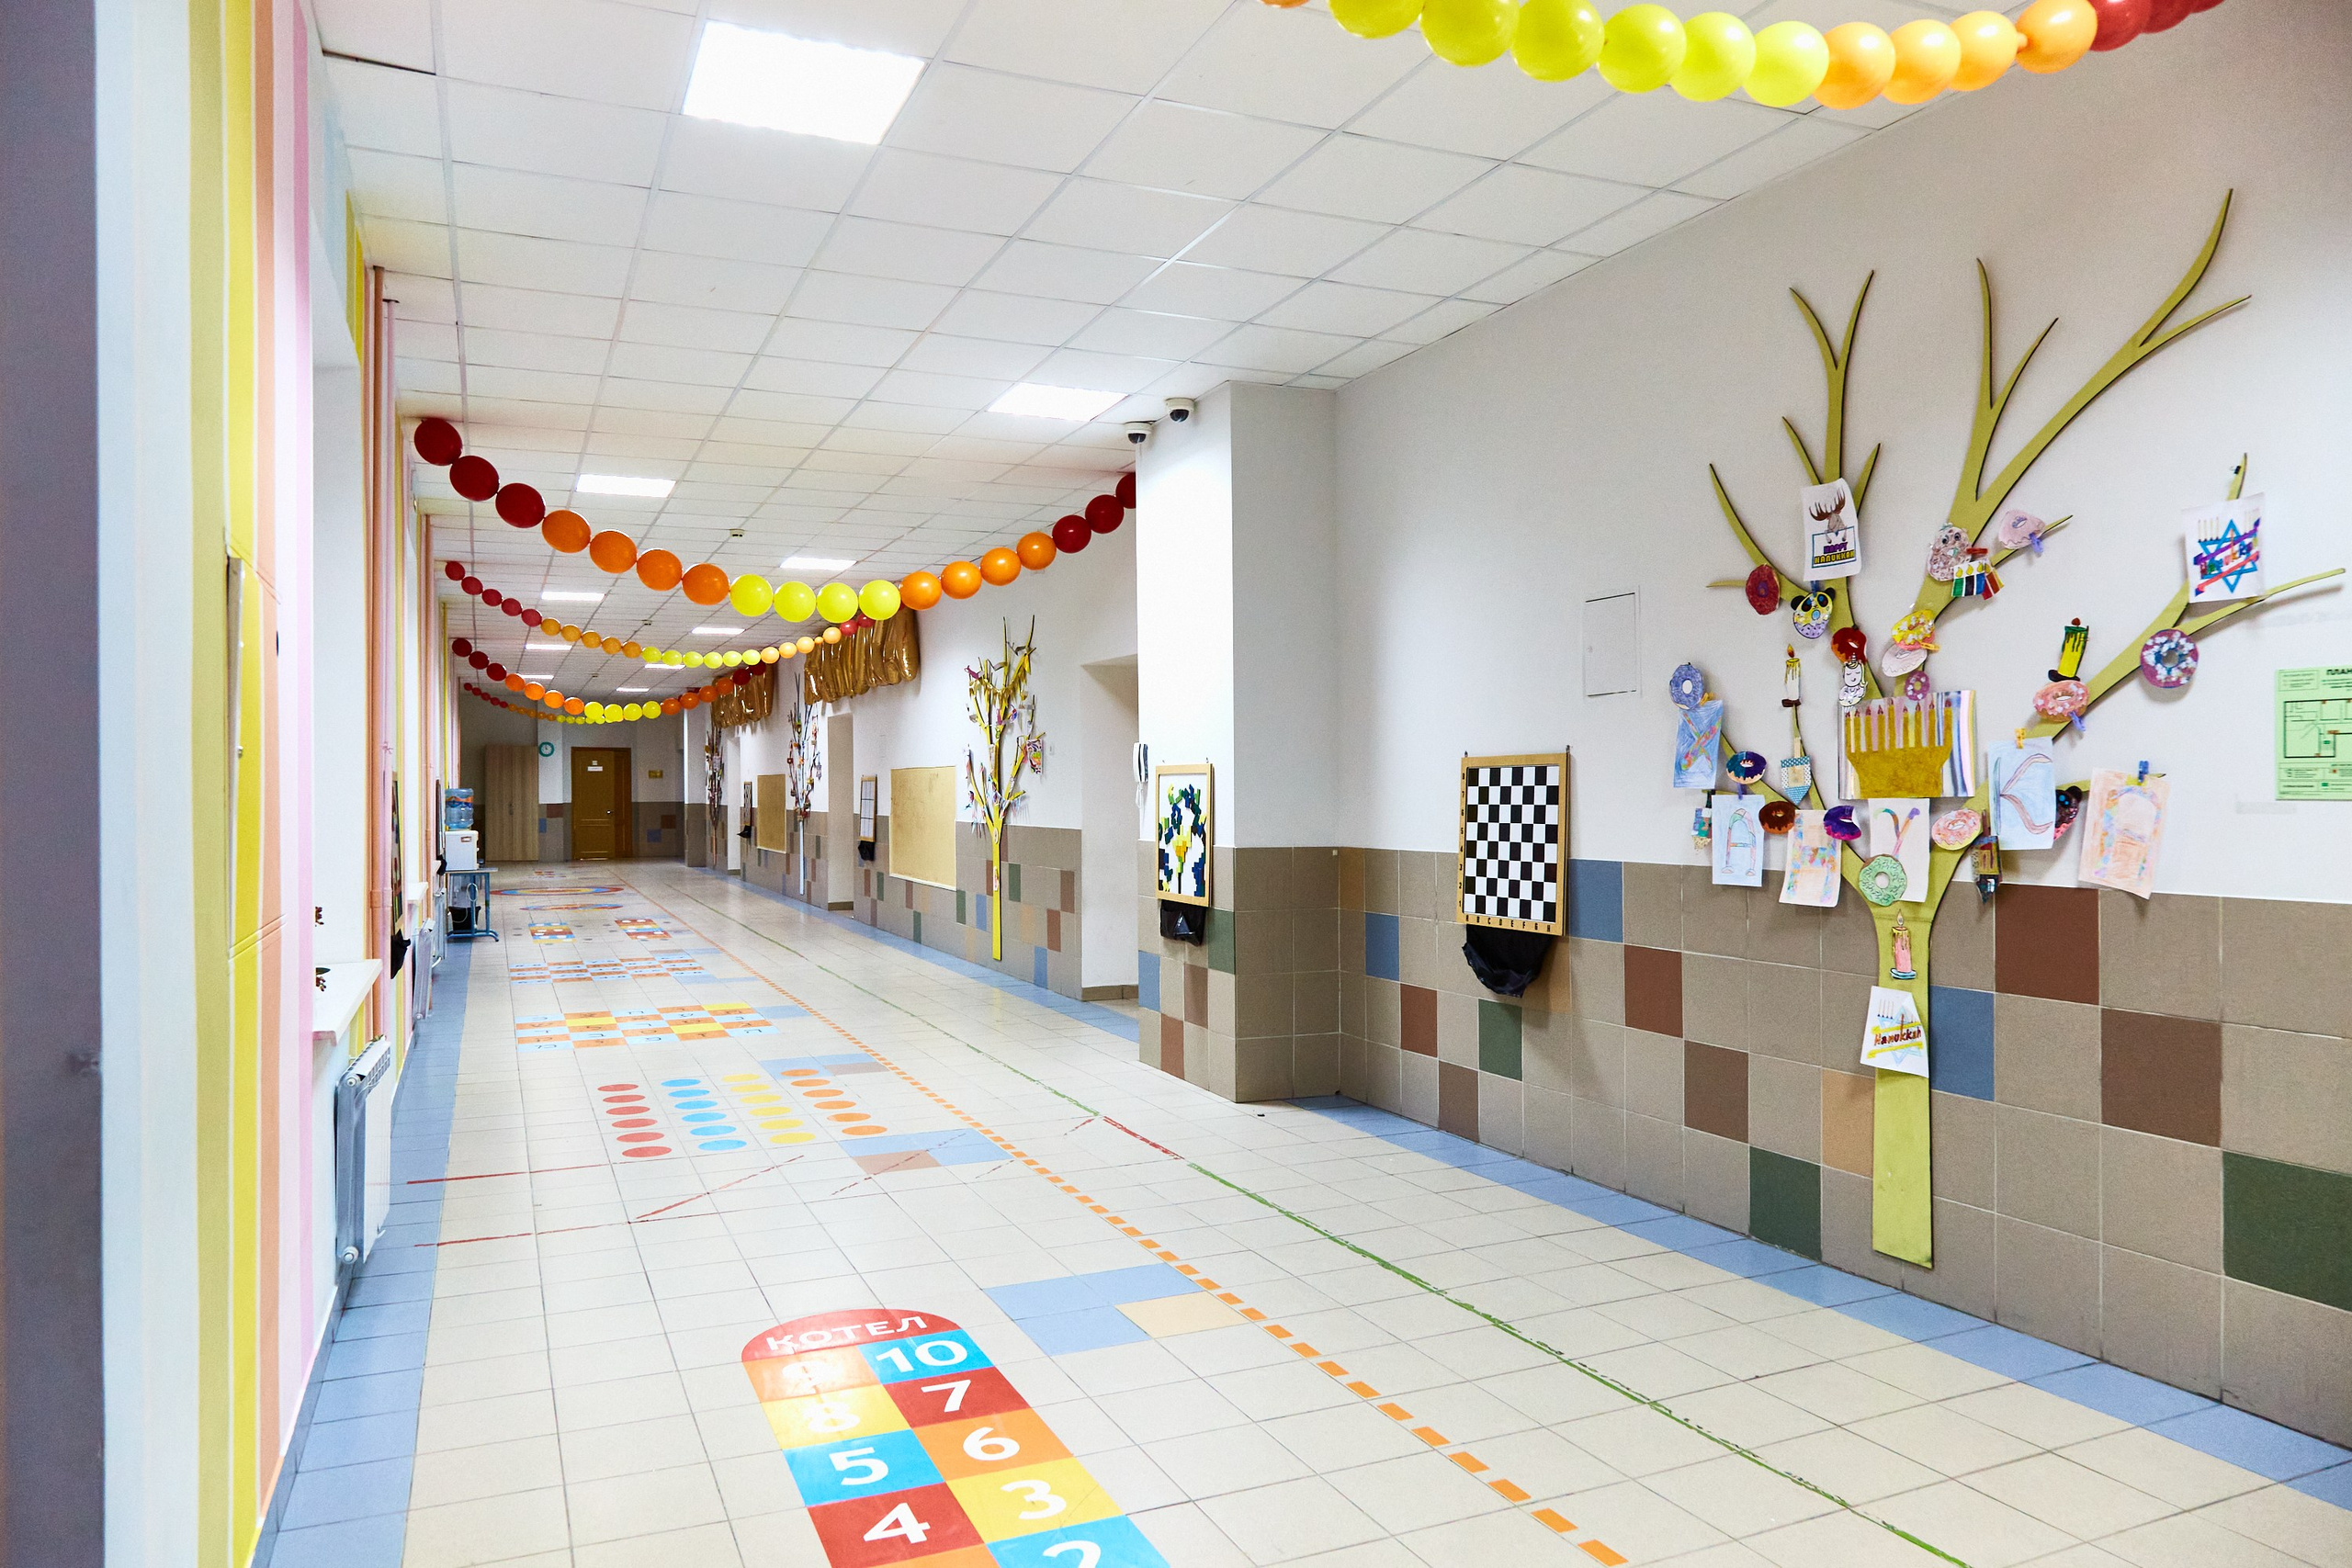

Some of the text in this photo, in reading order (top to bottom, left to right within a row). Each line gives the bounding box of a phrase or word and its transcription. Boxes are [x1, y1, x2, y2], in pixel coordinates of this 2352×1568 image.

[1815, 549, 1855, 564] HANUKKAH
[1824, 542, 1848, 554] HAPPY
[766, 1315, 927, 1354] КОТЕЛ
[876, 1339, 968, 1373] 10
[921, 1379, 972, 1413] 7
[801, 1394, 861, 1433] 8
[963, 1427, 1021, 1461] 6
[829, 1447, 889, 1486] 5
[1000, 1480, 1067, 1520] 3
[863, 1502, 931, 1545] 4
[1042, 1540, 1102, 1568] 2
